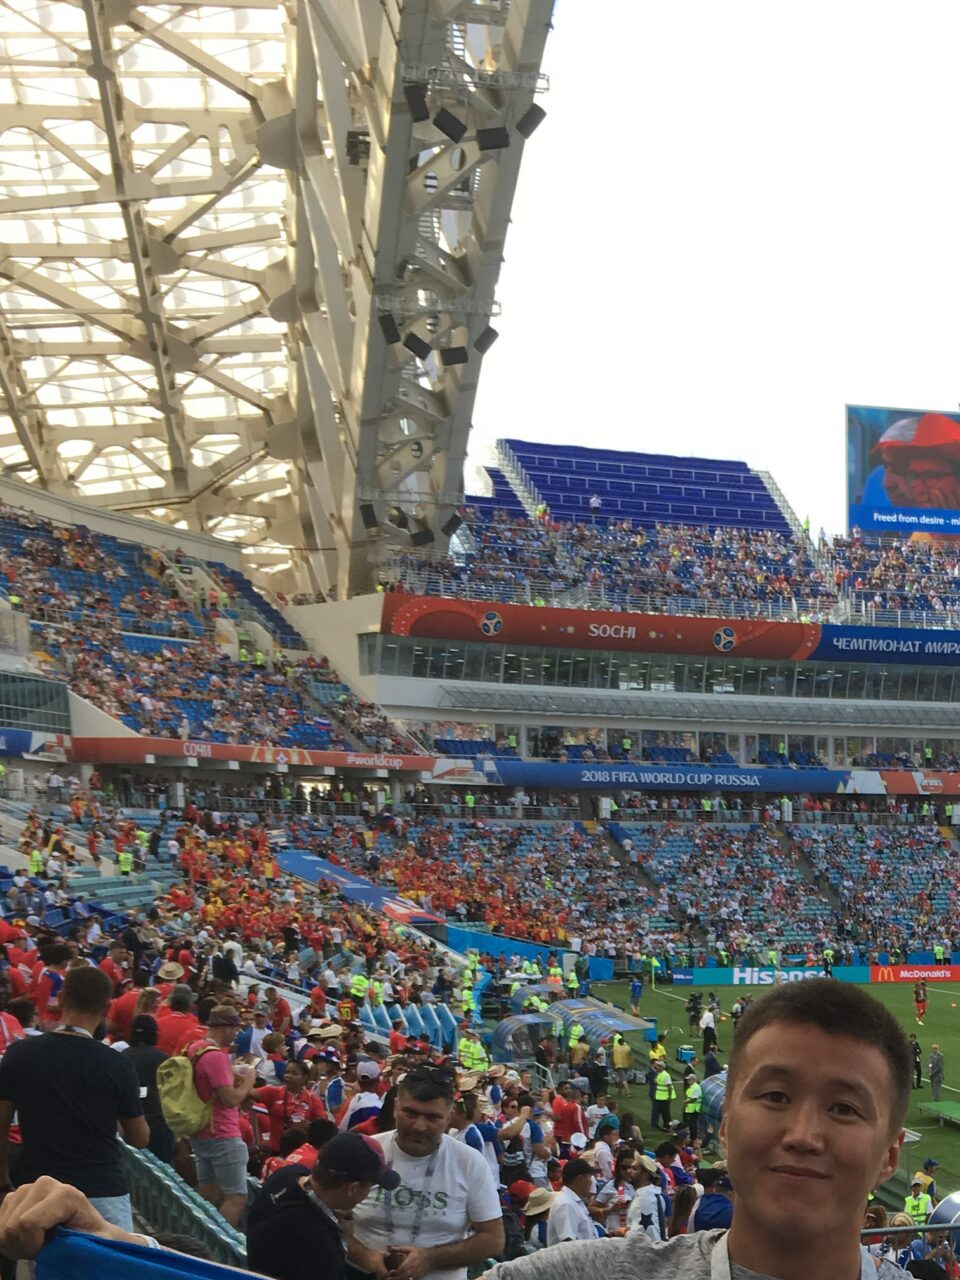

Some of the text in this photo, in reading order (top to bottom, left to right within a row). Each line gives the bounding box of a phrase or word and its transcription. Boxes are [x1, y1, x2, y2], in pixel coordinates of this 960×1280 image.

[873, 512, 897, 523] Freed
[898, 514, 918, 525] from
[919, 515, 944, 526] desire
[588, 623, 637, 639] SOCHI
[832, 637, 923, 653] ЧЕМПИОНАТ
[347, 753, 404, 769] #worldcup
[580, 770, 761, 786] 2018 FIFA WORLD CUP RUSSIA
[900, 969, 951, 979] McDonald's
